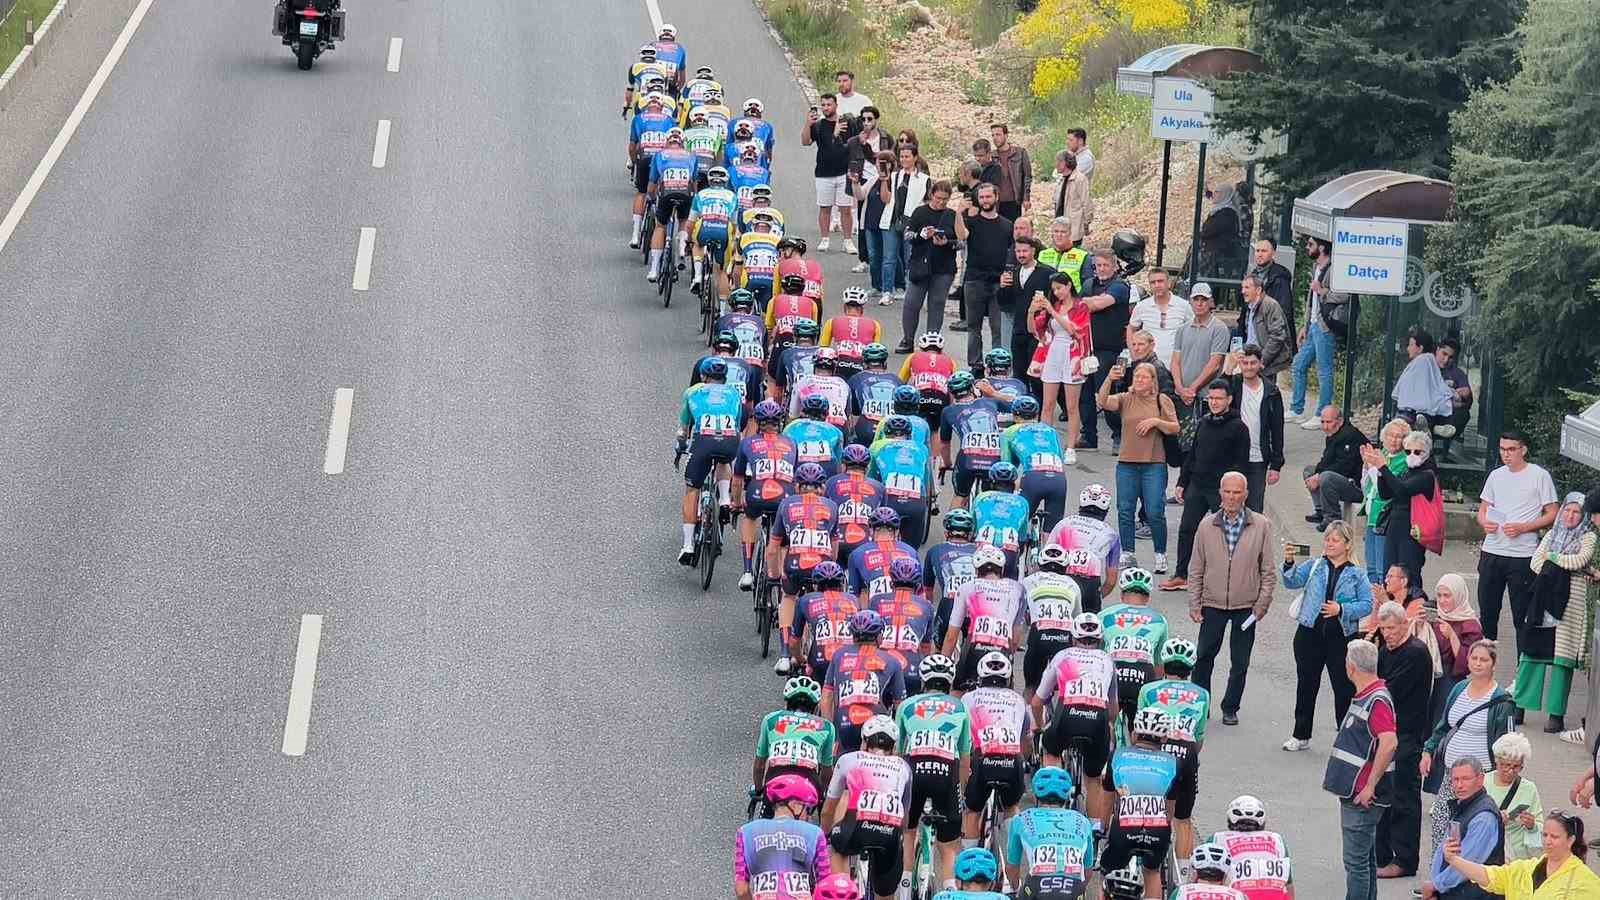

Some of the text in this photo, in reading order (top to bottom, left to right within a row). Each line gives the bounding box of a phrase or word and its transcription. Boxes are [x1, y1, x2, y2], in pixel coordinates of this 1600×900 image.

[1174, 89, 1193, 101] Ula
[666, 168, 688, 180] 12 12
[1337, 231, 1404, 247] Marmaris
[1347, 264, 1389, 280] Datça
[865, 401, 882, 414] 154
[704, 415, 732, 428] 2 2
[802, 441, 825, 454] 3 3
[966, 433, 982, 448] 157
[758, 459, 771, 472] 24
[839, 502, 853, 515] 26
[791, 530, 830, 547] 27 27
[982, 526, 989, 539] 4
[1073, 550, 1088, 564] 33
[1038, 604, 1070, 620] 34 34
[817, 623, 831, 638] 23
[975, 618, 1009, 637] 36 36
[1114, 636, 1149, 652] 52 52
[840, 681, 878, 697] 25 25
[1069, 681, 1103, 697] 31 31
[1178, 715, 1193, 733] 54
[915, 731, 951, 748] 51 51
[1001, 727, 1016, 743] 35
[773, 741, 815, 759] 53 53
[916, 761, 949, 772] KERN
[860, 791, 877, 809] 37
[1120, 797, 1167, 816] 204 204
[1034, 847, 1056, 863] 132
[1235, 859, 1283, 878] 96 96
[754, 871, 810, 892] 125 125
[1040, 877, 1074, 889] CSF
